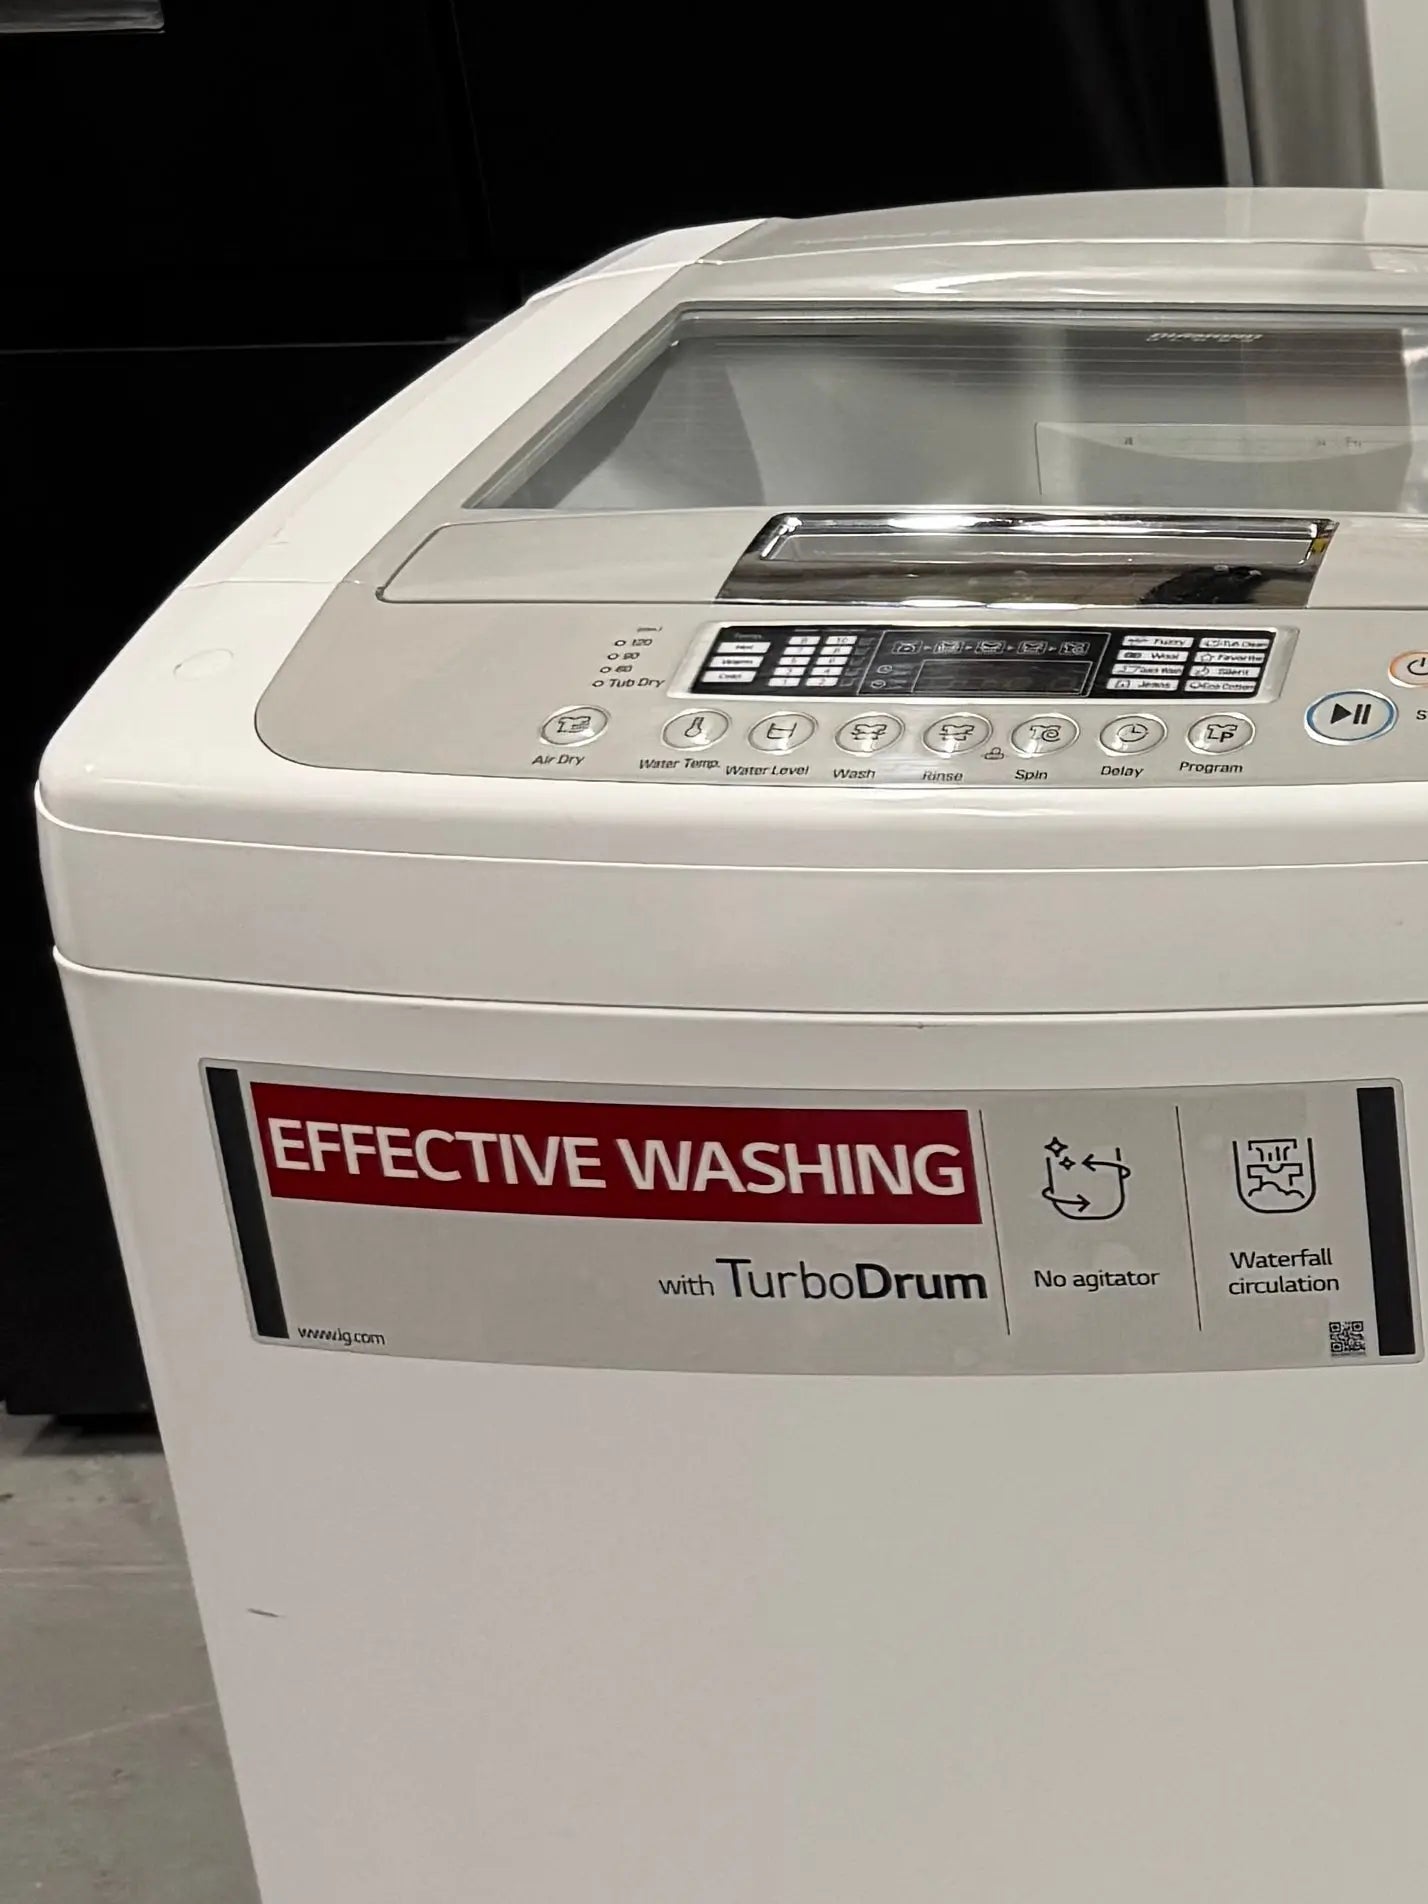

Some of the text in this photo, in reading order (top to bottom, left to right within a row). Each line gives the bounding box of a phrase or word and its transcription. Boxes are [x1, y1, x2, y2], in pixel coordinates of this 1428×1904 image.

[609, 678, 664, 688] Tub Dry
[532, 754, 584, 767] Air Dry
[639, 759, 680, 769] Water
[726, 765, 809, 776] Water Level
[833, 769, 875, 779] Wash
[1101, 765, 1144, 778] Delay
[1179, 761, 1242, 776] Program
[922, 770, 963, 782] Rinse
[1015, 769, 1048, 782] Spin
[268, 1117, 965, 1196] EFFECTIVE WASHING
[1230, 1247, 1332, 1270] Waterfall
[659, 1257, 988, 1300] with TurboDrum
[1035, 1269, 1160, 1292] No agitator
[1228, 1274, 1339, 1296] circulation
